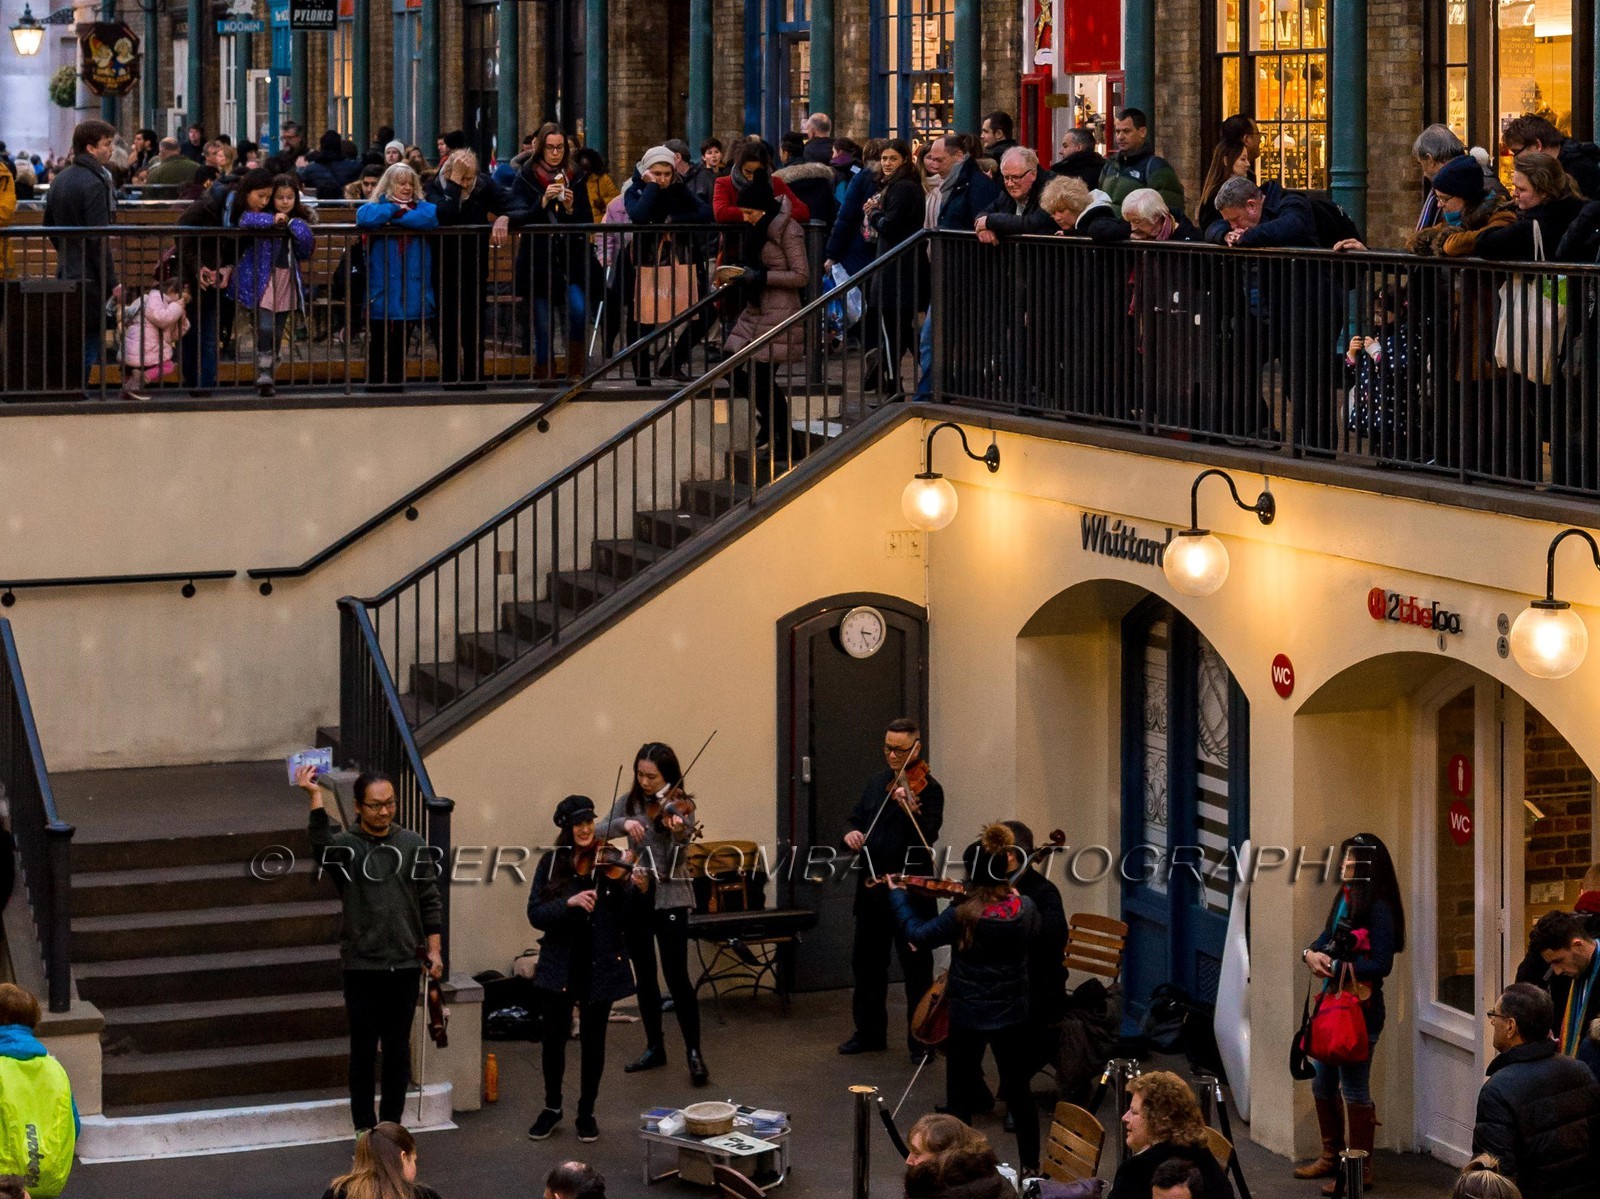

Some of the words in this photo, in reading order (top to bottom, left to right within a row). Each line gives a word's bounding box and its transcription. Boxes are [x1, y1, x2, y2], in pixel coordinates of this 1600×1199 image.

[1080, 511, 1173, 568] Whittard
[1273, 665, 1291, 685] WC
[1450, 811, 1470, 833] WC
